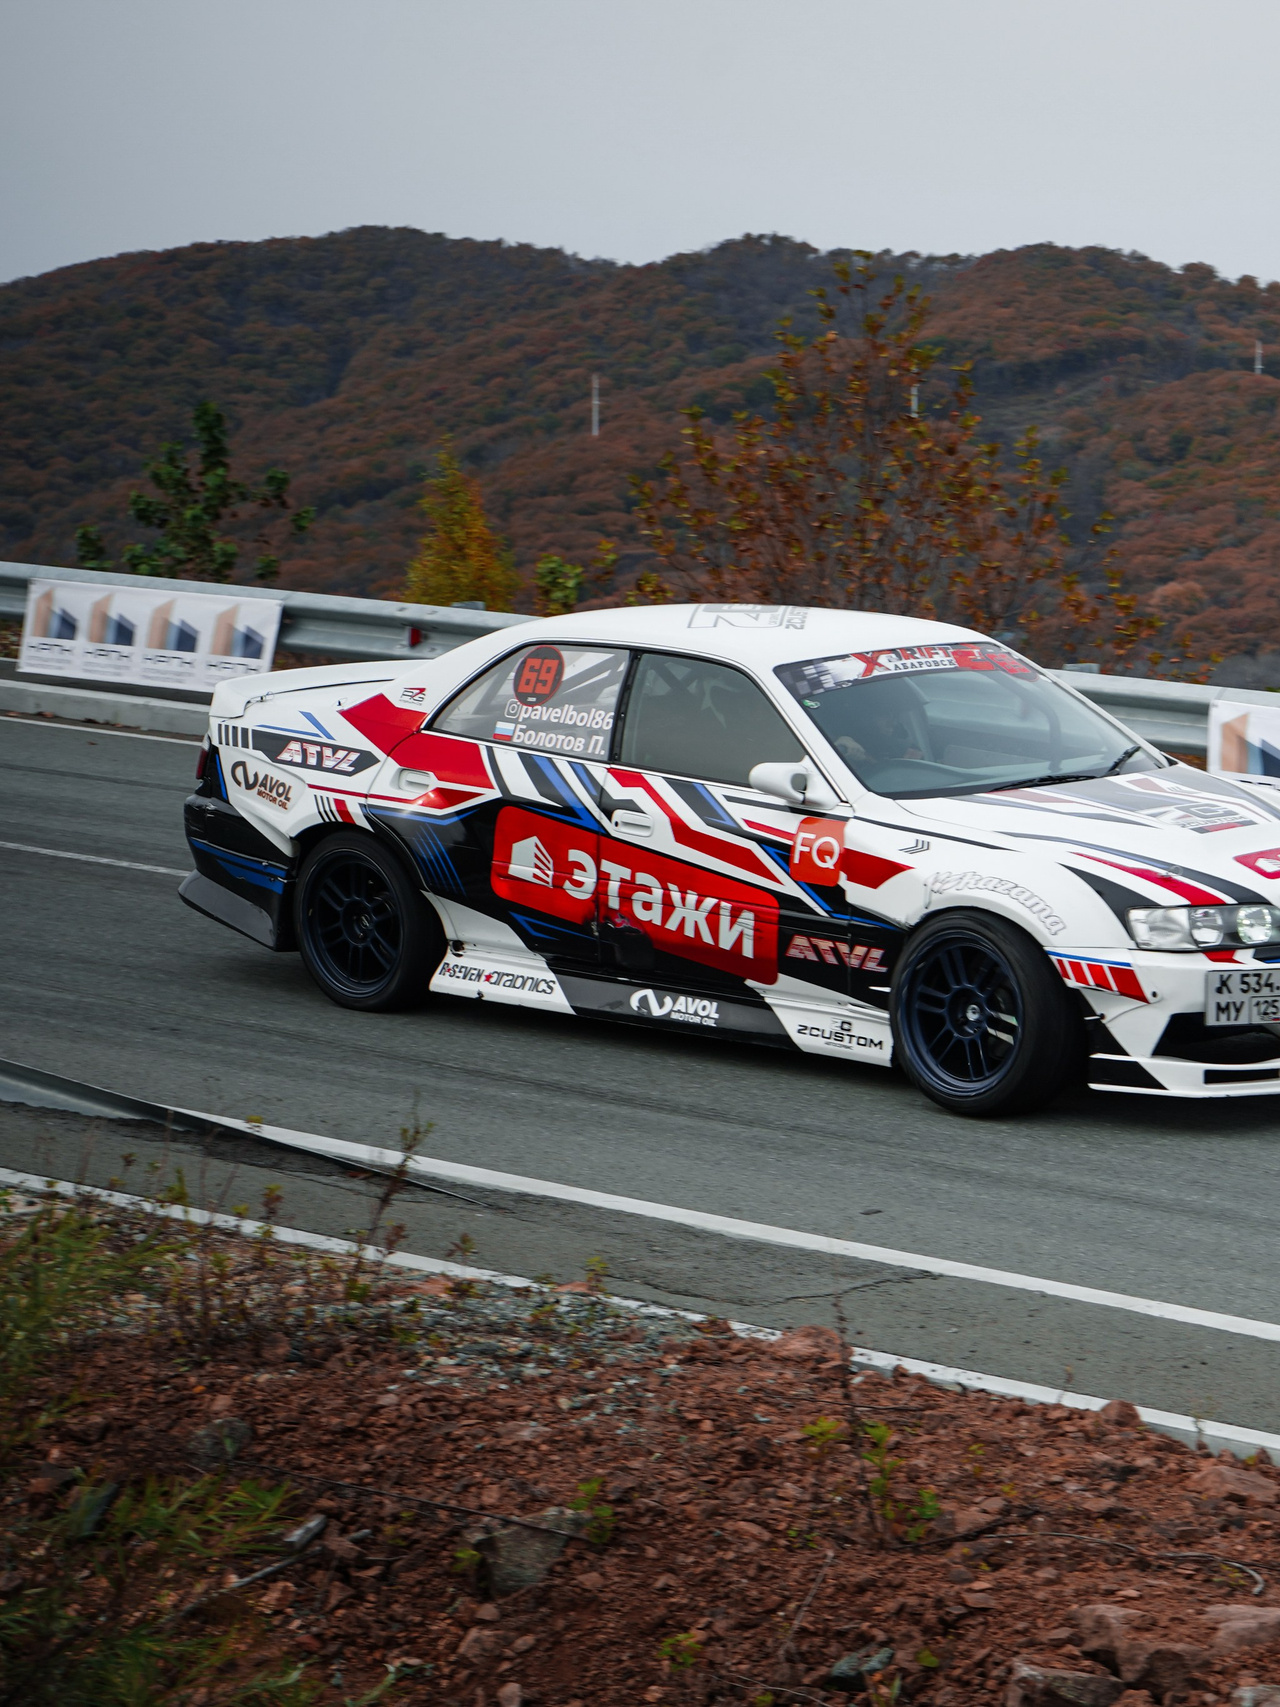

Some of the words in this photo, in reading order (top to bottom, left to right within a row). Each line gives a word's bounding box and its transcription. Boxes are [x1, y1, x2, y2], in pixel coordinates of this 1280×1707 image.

[517, 658, 560, 695] 69
[518, 704, 615, 730] pavelbol86
[512, 724, 585, 752] Болотов
[587, 735, 606, 755] П.
[257, 788, 278, 804] MOTOR
[793, 832, 840, 869] FQ
[1240, 973, 1274, 993] 534
[670, 1011, 702, 1024] MOTOR
[1254, 1000, 1279, 1016] 125
